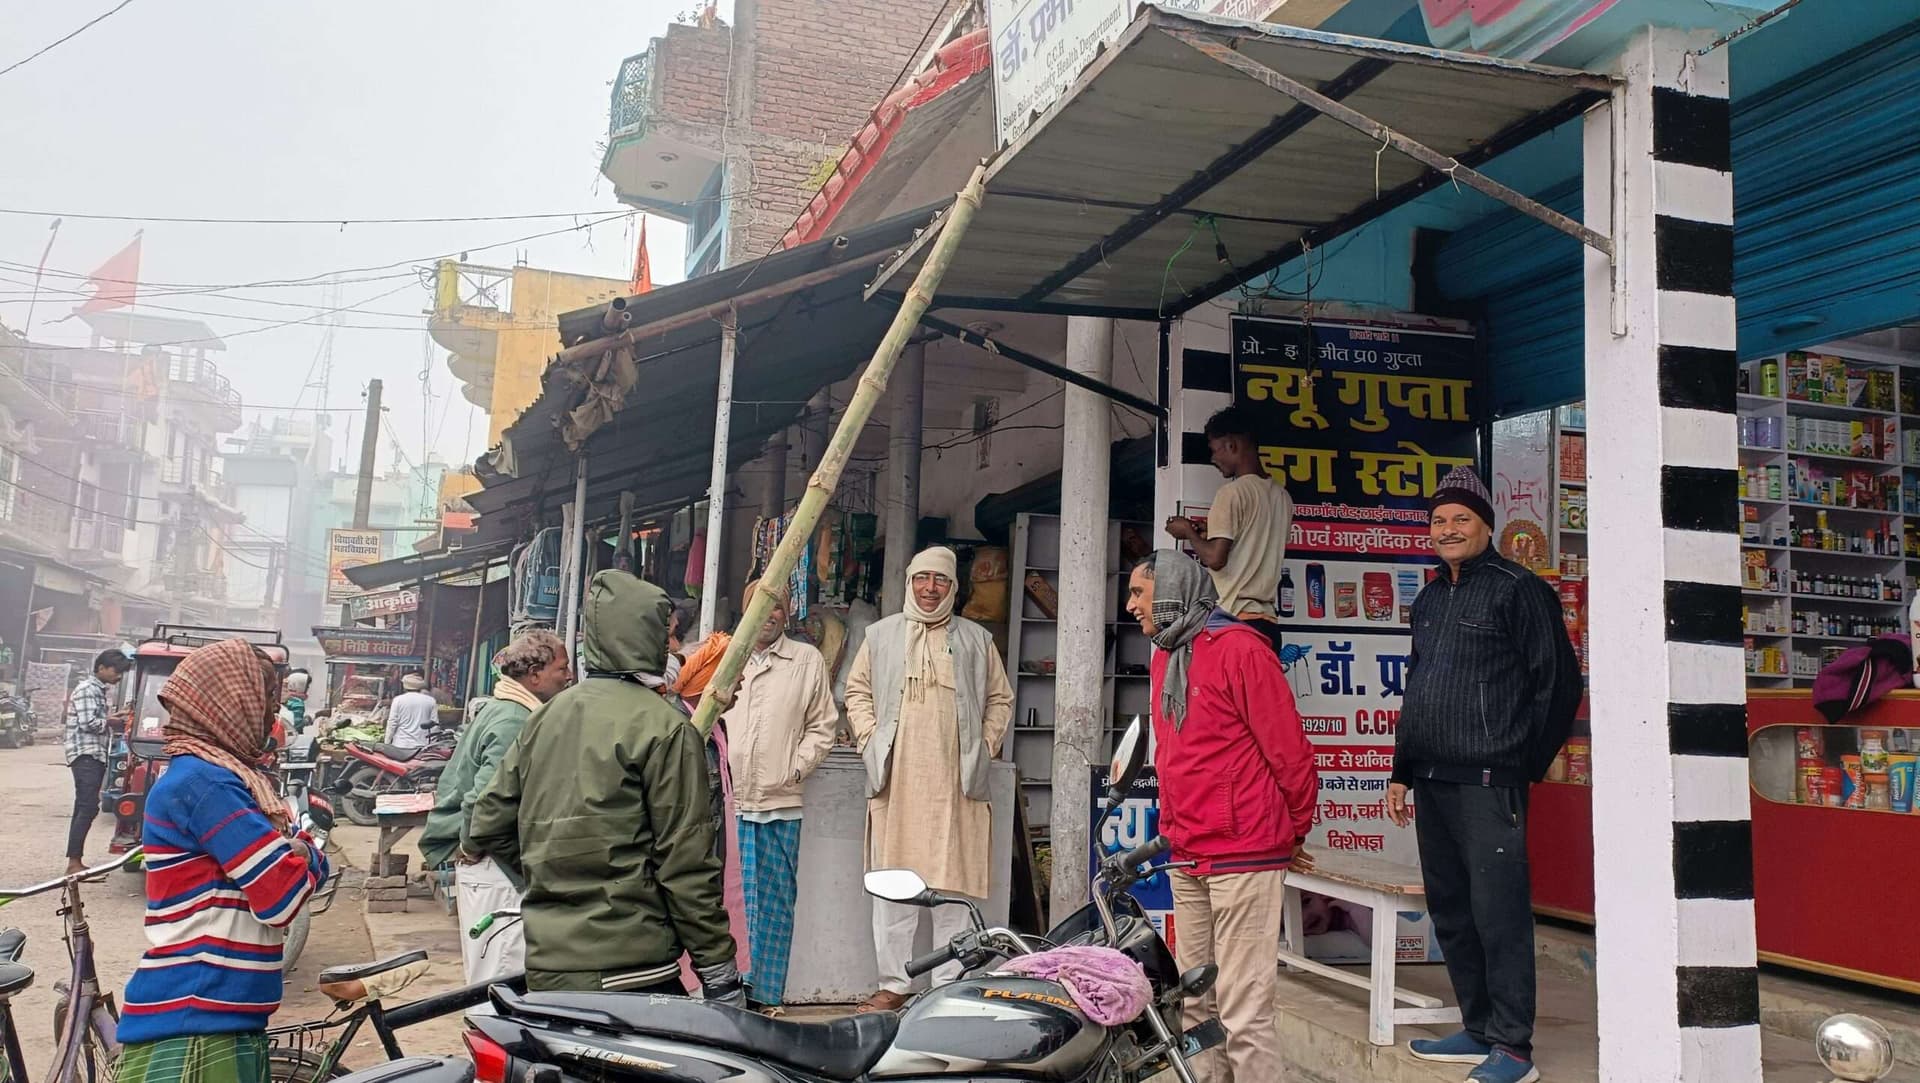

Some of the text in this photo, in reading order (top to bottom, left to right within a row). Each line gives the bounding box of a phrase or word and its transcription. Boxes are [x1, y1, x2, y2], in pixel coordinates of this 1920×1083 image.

[1034, 69, 1056, 99] Society
[1057, 48, 1079, 81] Health
[1079, 5, 1122, 56] Department
[1383, 352, 1422, 371] गुप्ता
[1240, 363, 1473, 432] न्यू गुप्ता
[1306, 525, 1331, 546] एवं
[366, 590, 417, 611] आकृति
[1316, 641, 1410, 698] डॉ. प्र
[1339, 750, 1352, 767] से
[1355, 750, 1394, 768] शनिव
[1325, 776, 1346, 791] बजे
[1347, 776, 1359, 791] से
[1360, 779, 1385, 791] शाम
[1327, 830, 1384, 851] विशेषज्ञ
